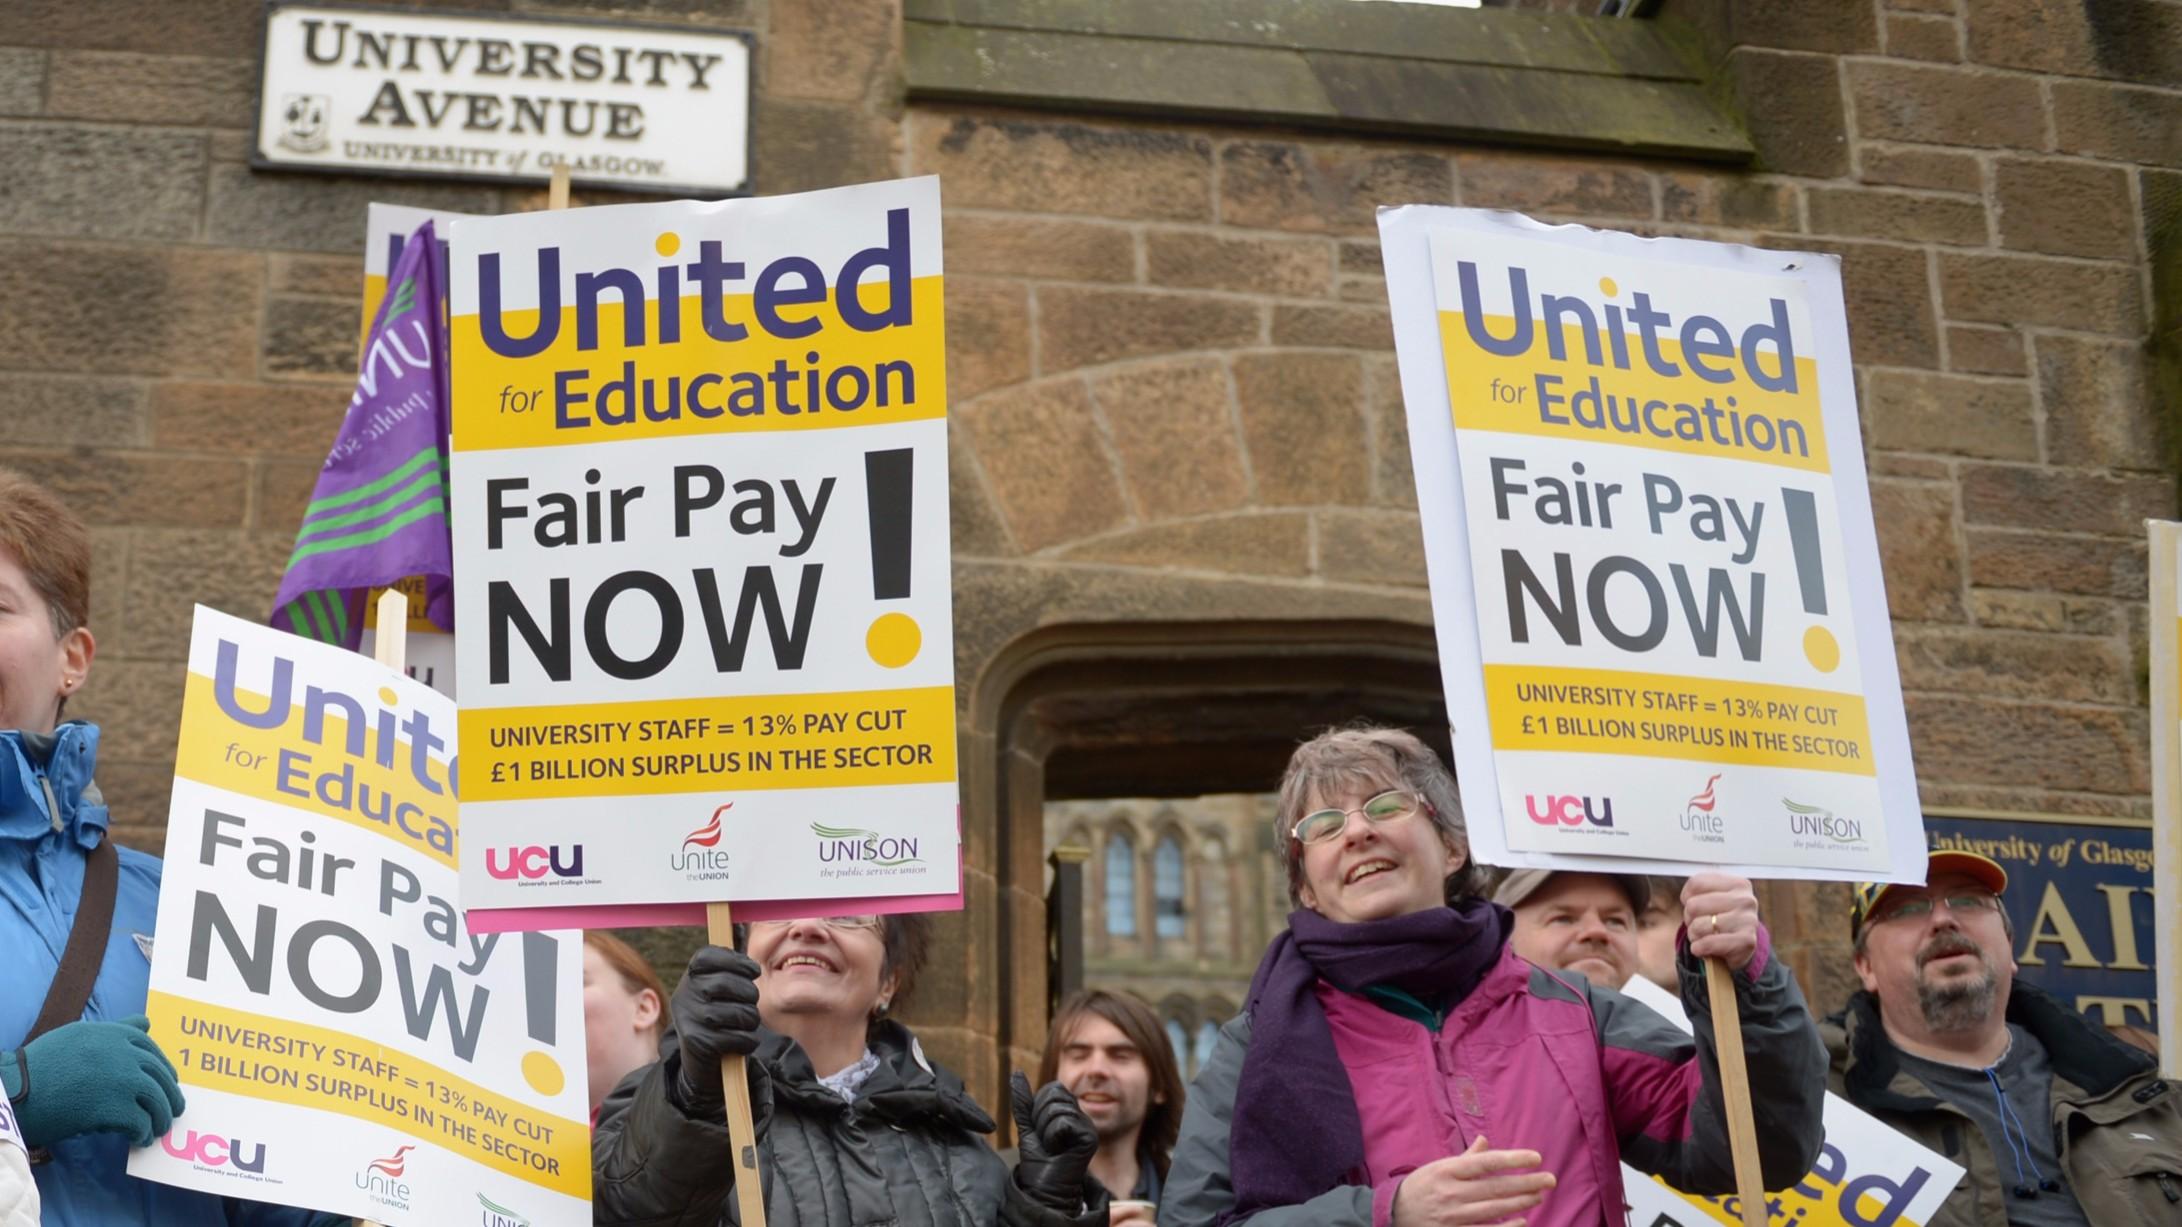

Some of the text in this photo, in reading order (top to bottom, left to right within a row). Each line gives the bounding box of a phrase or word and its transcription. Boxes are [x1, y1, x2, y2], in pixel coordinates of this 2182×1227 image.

[301, 19, 721, 91] UNIVERSITY
[357, 79, 646, 141] AVENUE
[344, 140, 499, 168] UNIVERSITY
[505, 149, 528, 173] of
[478, 208, 912, 359] United
[1457, 261, 1798, 395] United
[498, 351, 915, 429] for Education
[1490, 373, 1808, 457] for Education
[487, 464, 837, 557] Fair Pay
[1490, 456, 1764, 565] Fair Pay
[488, 563, 823, 684] NOW
[1501, 548, 1765, 663] NOW
[490, 722, 632, 748] UNIVERSITY
[639, 717, 711, 742] STAFF
[743, 714, 797, 737] 13%
[804, 710, 848, 735] PAY
[856, 709, 907, 732] CUT
[1517, 683, 1636, 708] UNIVERSITY
[1643, 690, 1699, 713] STAFF
[1722, 698, 1763, 720] 13%
[1767, 702, 1798, 723] PAY
[1804, 706, 1837, 727] CUT
[1556, 716, 1635, 739] BILLION
[1642, 721, 1724, 747] SURPLUS
[1730, 730, 1748, 749] IN
[1753, 731, 1788, 752] THE
[1793, 735, 1860, 760] SECTOR
[225, 742, 458, 858] for Educa
[530, 756, 625, 781] BILLION
[632, 752, 741, 778] SURPLUS
[748, 750, 772, 773] IN
[778, 748, 827, 772] THE
[834, 743, 933, 769] SECTOR
[819, 837, 918, 862] UNISON
[1791, 815, 1861, 838] UNISON
[2050, 837, 2075, 867] of
[199, 808, 501, 976] Fair Pay
[820, 866, 927, 879] the public service union
[186, 890, 490, 1063] NOW
[181, 1016, 326, 1061] UNIVERSITY
[333, 1049, 399, 1082] STAFF
[426, 1081, 468, 1112] 13%
[473, 1101, 508, 1127] PAY
[514, 1119, 554, 1144] CUT
[200, 1052, 299, 1088] BILLION
[305, 1074, 408, 1117] SURPLUS
[414, 1106, 434, 1128] IN
[440, 1115, 477, 1145] THE
[482, 1134, 560, 1176] SECTOR
[193, 1165, 225, 1177] University
[227, 1170, 238, 1178] and
